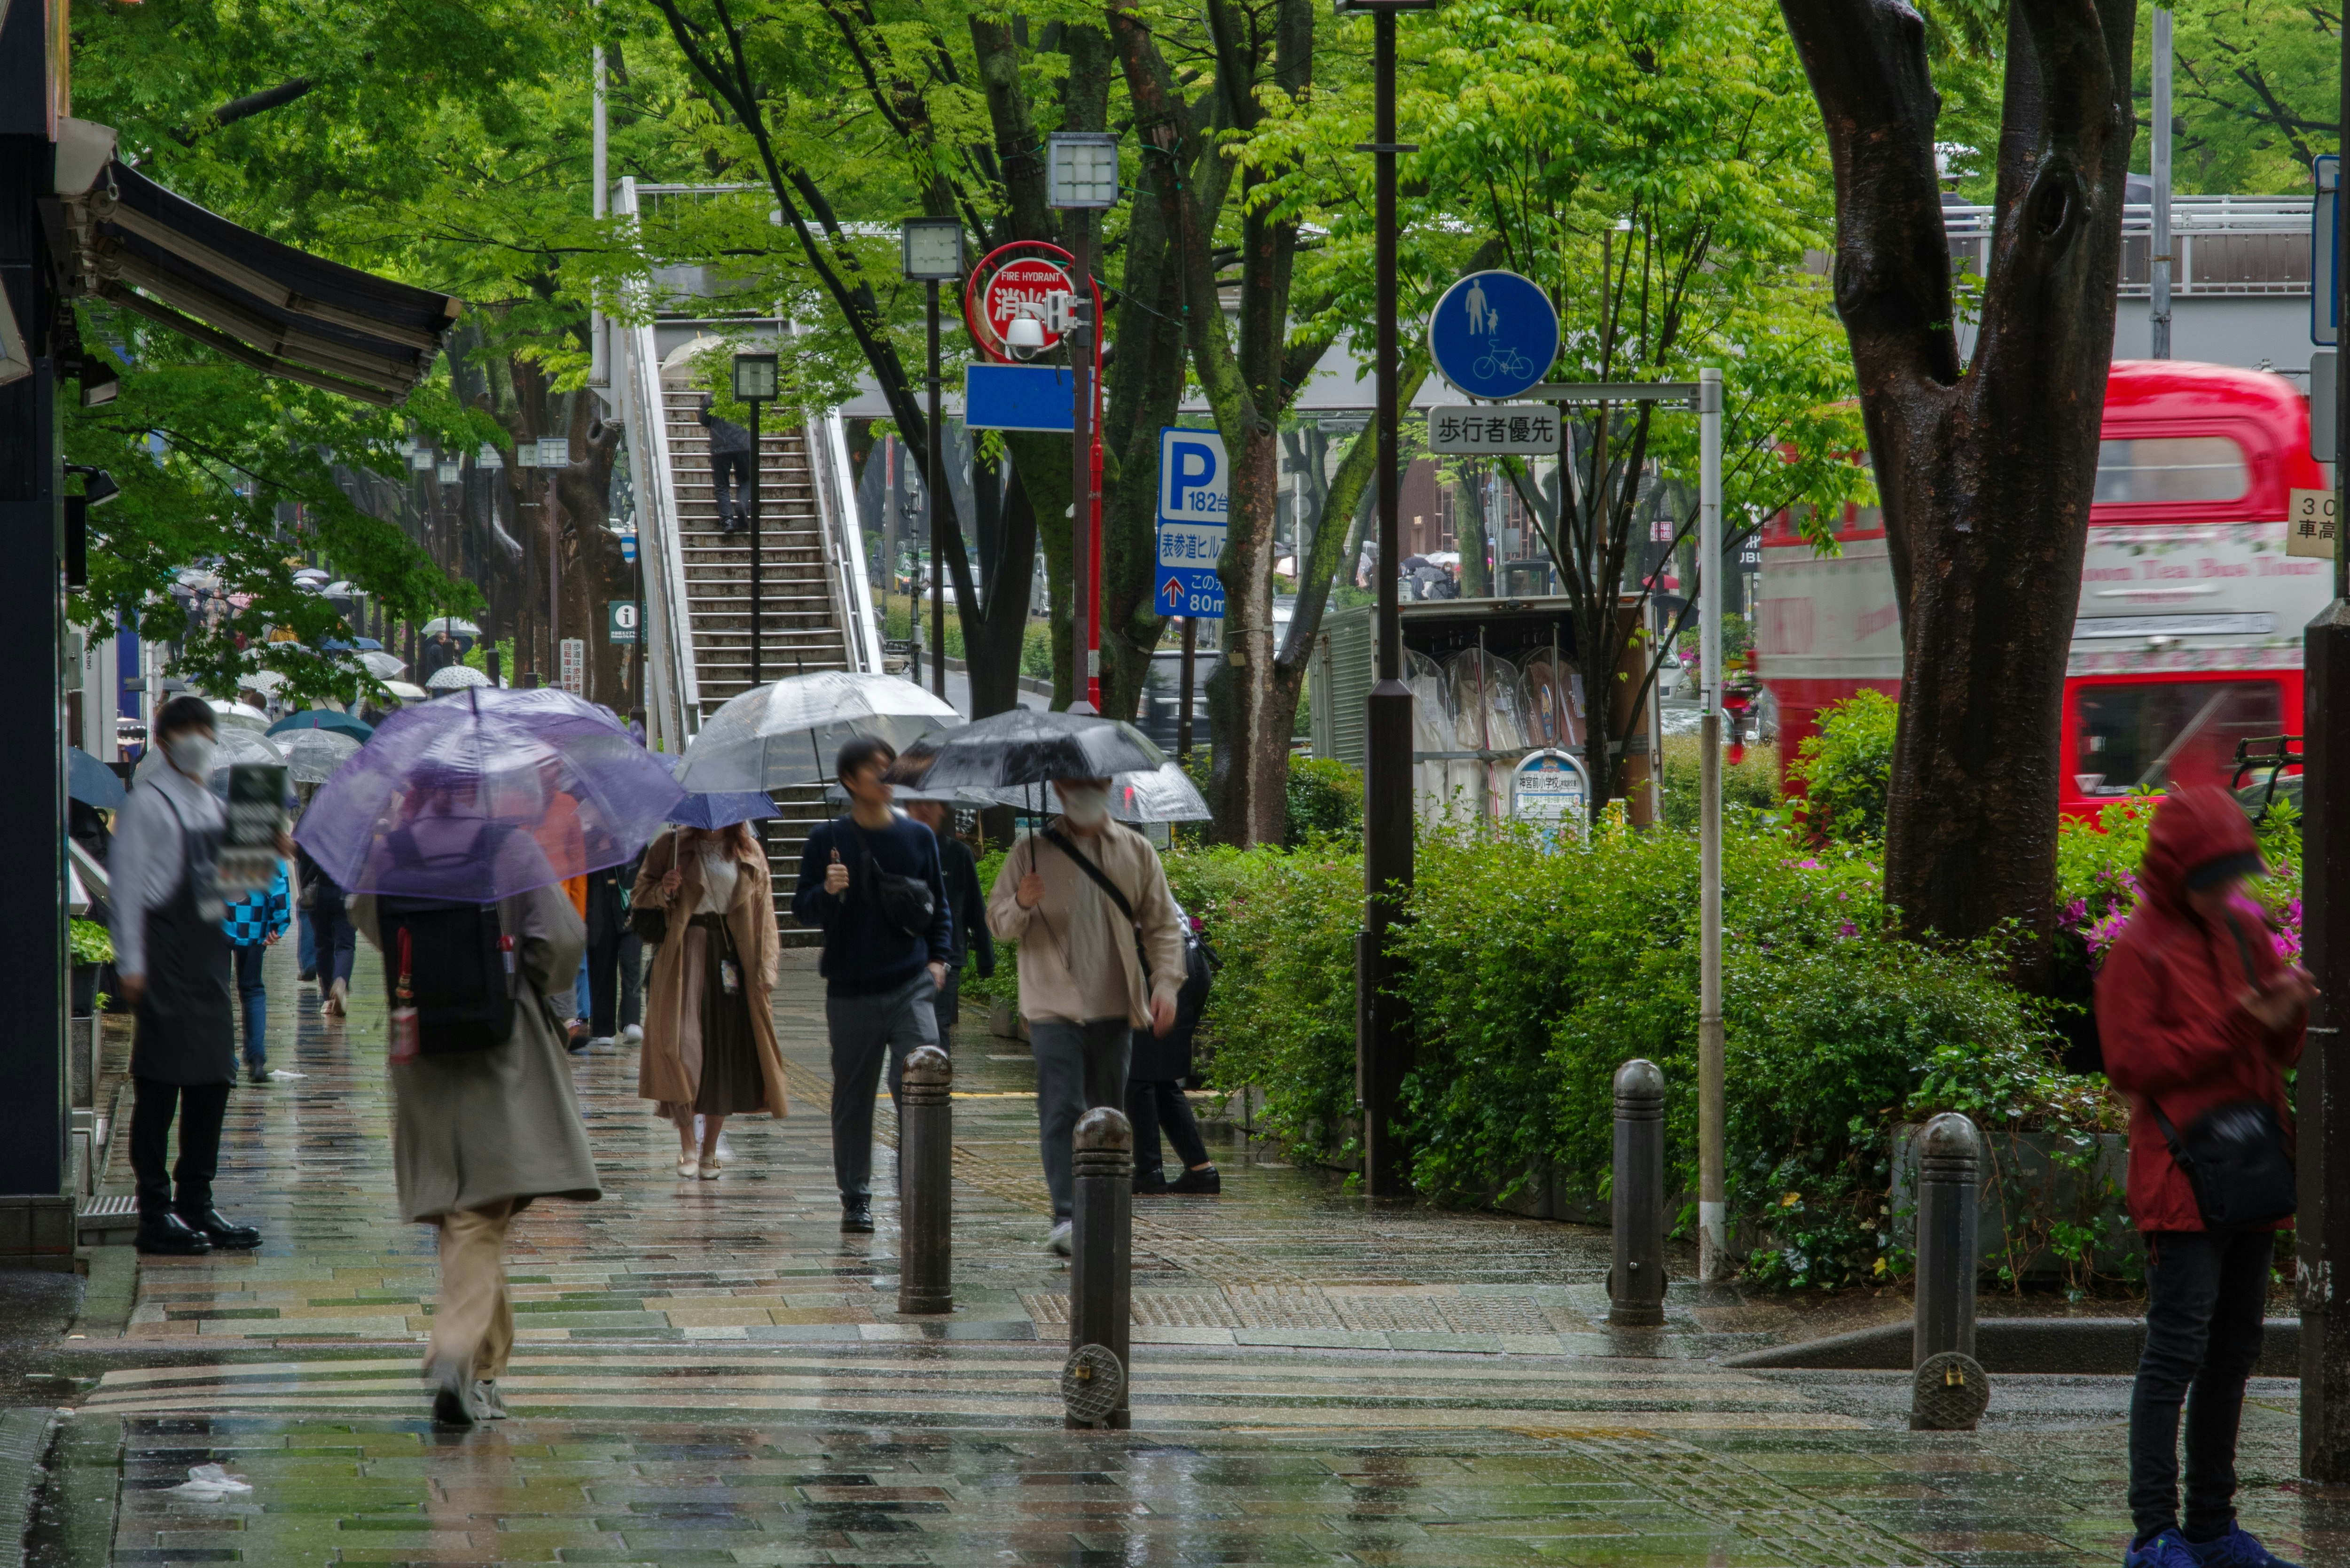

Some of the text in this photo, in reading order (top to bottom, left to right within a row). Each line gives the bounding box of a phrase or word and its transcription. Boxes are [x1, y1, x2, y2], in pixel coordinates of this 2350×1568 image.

[1001, 271, 1060, 282] FIRE HYDRANT
[995, 287, 1063, 321] 消火
[1438, 416, 1553, 443] 歩行者優先
[1170, 441, 1216, 511] P
[1188, 491, 1228, 513] 182台
[2297, 519, 2335, 540] 車高
[1162, 532, 1227, 560] 表参道ヒル
[1190, 594, 1225, 612] 80m
